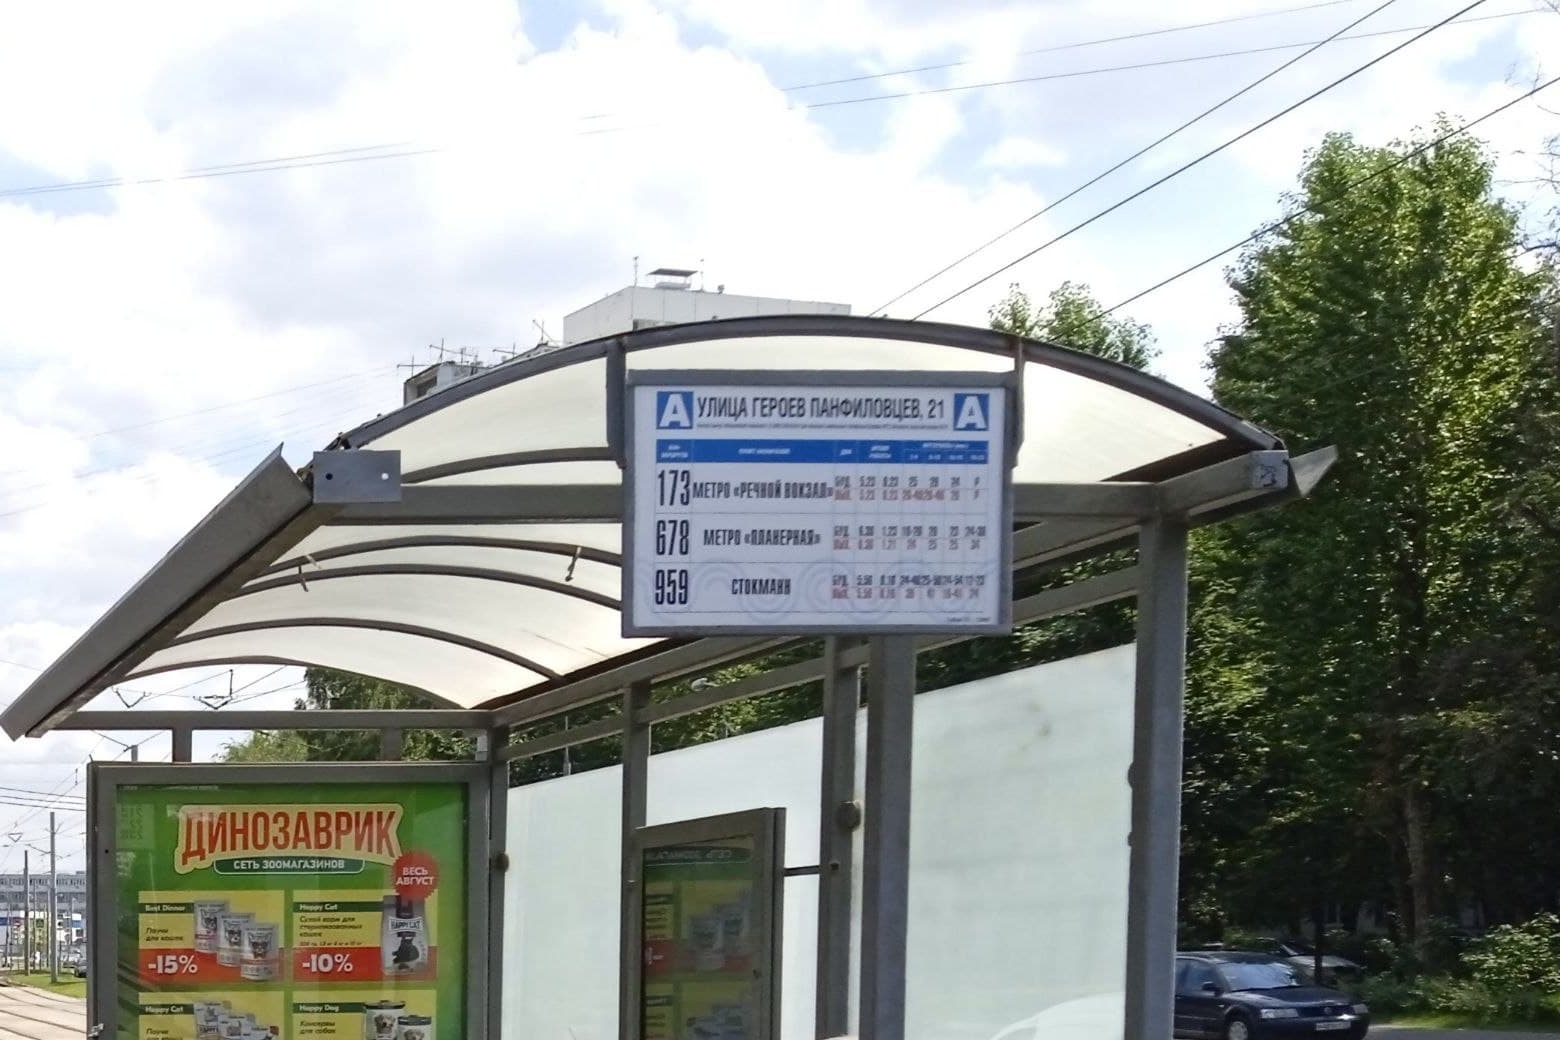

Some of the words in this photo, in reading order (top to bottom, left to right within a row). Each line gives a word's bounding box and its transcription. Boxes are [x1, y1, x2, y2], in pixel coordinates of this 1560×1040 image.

[697, 397, 747, 421] УЛИЦА
[752, 397, 806, 418] ГЕРОЕВ
[927, 399, 944, 418] 21
[658, 470, 691, 506] 173
[693, 482, 730, 498] МЕТРО
[733, 479, 782, 498] «РЕЧНОЙ
[784, 482, 833, 498] ВОКЗАЛ»
[655, 519, 689, 556] 678
[704, 529, 740, 546] МЕТРО
[744, 529, 820, 546] «ПЛАНЕРНАЯ»
[655, 569, 689, 605] 959
[731, 578, 791, 596] СТОКМАНН
[182, 810, 398, 865] ДИНОЗАВРИК
[233, 860, 260, 870] СЕТЬ
[262, 859, 345, 870] ЗООМАГАЗИНОВ
[403, 867, 428, 875] ВЕСЬ
[396, 876, 434, 886] АВГУСТ
[148, 953, 198, 974] -15%
[302, 953, 353, 972] -10%
